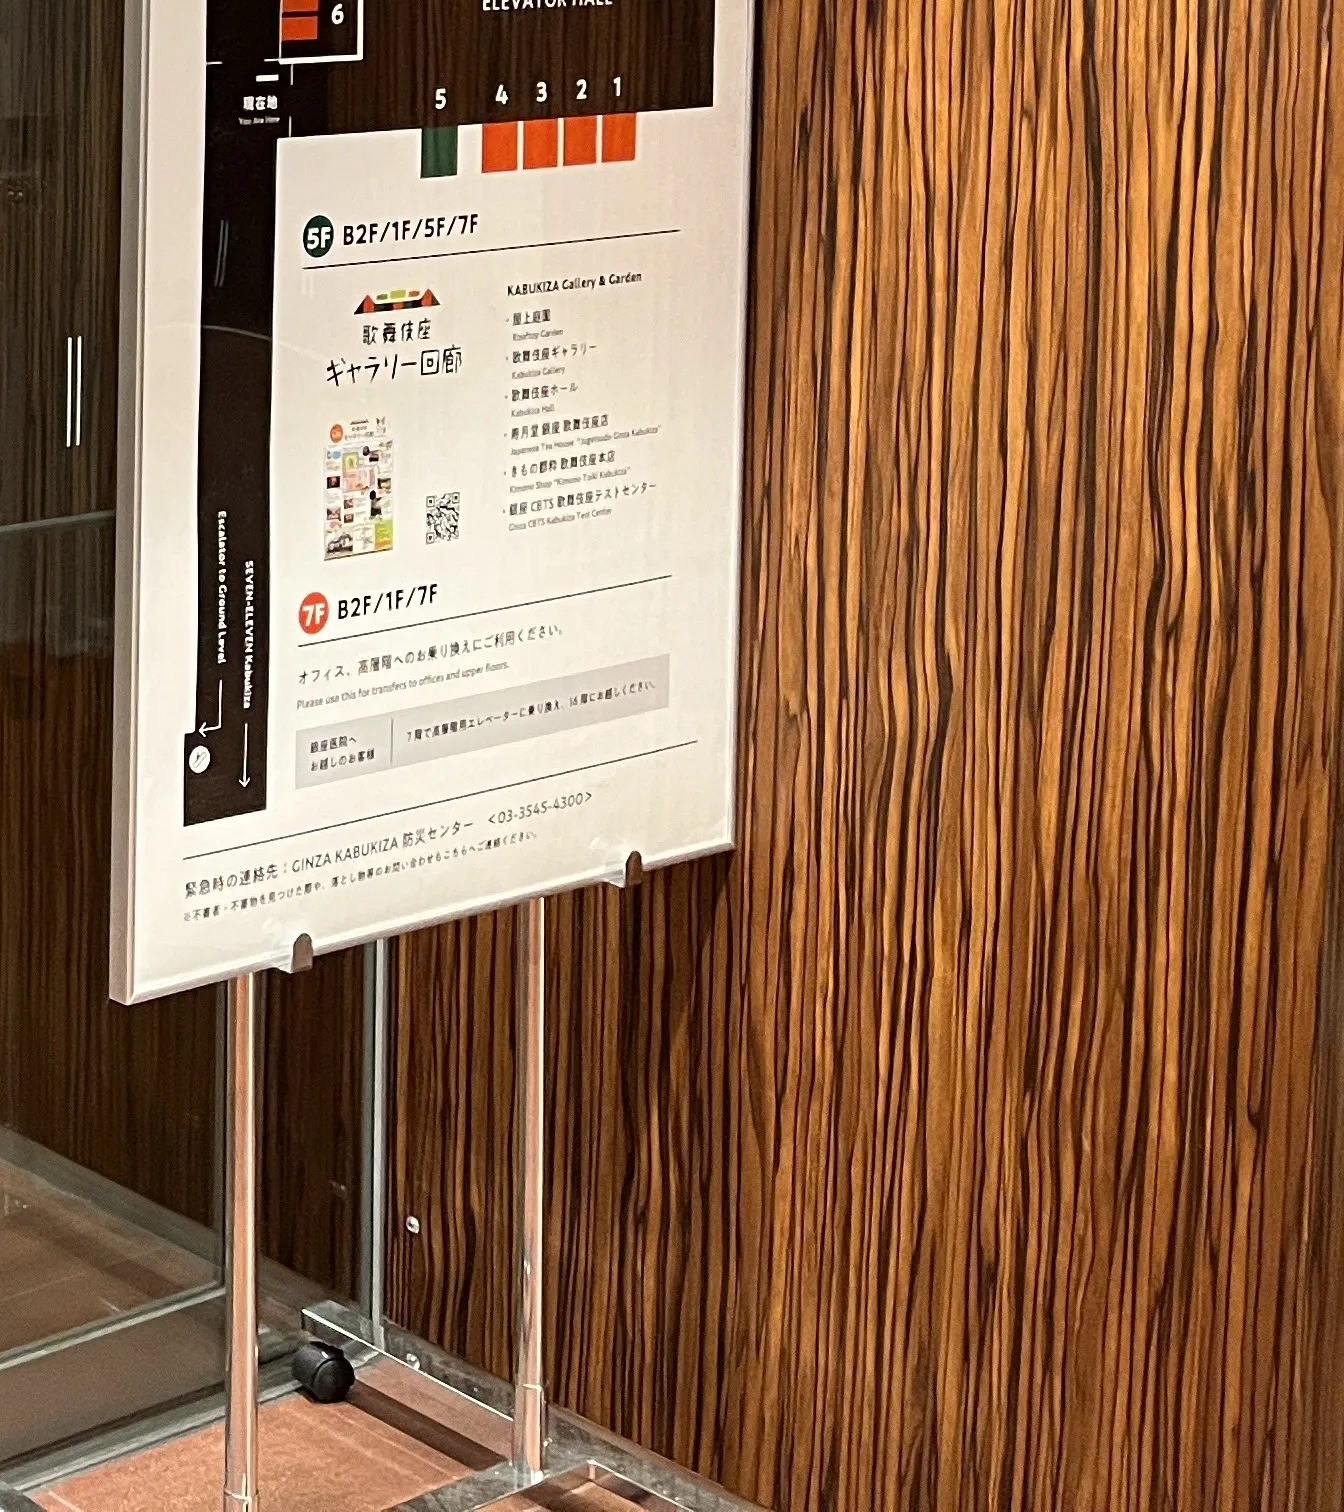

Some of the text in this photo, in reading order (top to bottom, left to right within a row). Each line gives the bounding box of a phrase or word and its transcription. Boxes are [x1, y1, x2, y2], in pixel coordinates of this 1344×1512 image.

[331, 3, 344, 25] 6
[435, 76, 621, 109] 5 4 3 2 1
[306, 213, 479, 250] 5F B2F/1F/5F/7F
[507, 271, 642, 296] KABUKIZA Gallery & Garden
[362, 318, 432, 346] 歌舞伎座
[326, 344, 463, 387] ギャラリー回廊
[530, 497, 554, 512] CBTS
[217, 510, 227, 664] Escalator to Ground Level
[302, 583, 438, 627] 7F B2F/1F/7F
[243, 560, 254, 709] SEVEN-ELEVEN Kabukiza
[296, 697, 323, 710] Please
[325, 694, 340, 704] use
[341, 690, 357, 702] this
[358, 688, 370, 699] for
[371, 680, 407, 695] transfers
[409, 679, 417, 688] to
[418, 673, 445, 687] offices
[445, 669, 461, 681] and
[292, 853, 331, 873] GINZA
[335, 836, 398, 863] KABUKIZA
[402, 821, 474, 848] 防災センター
